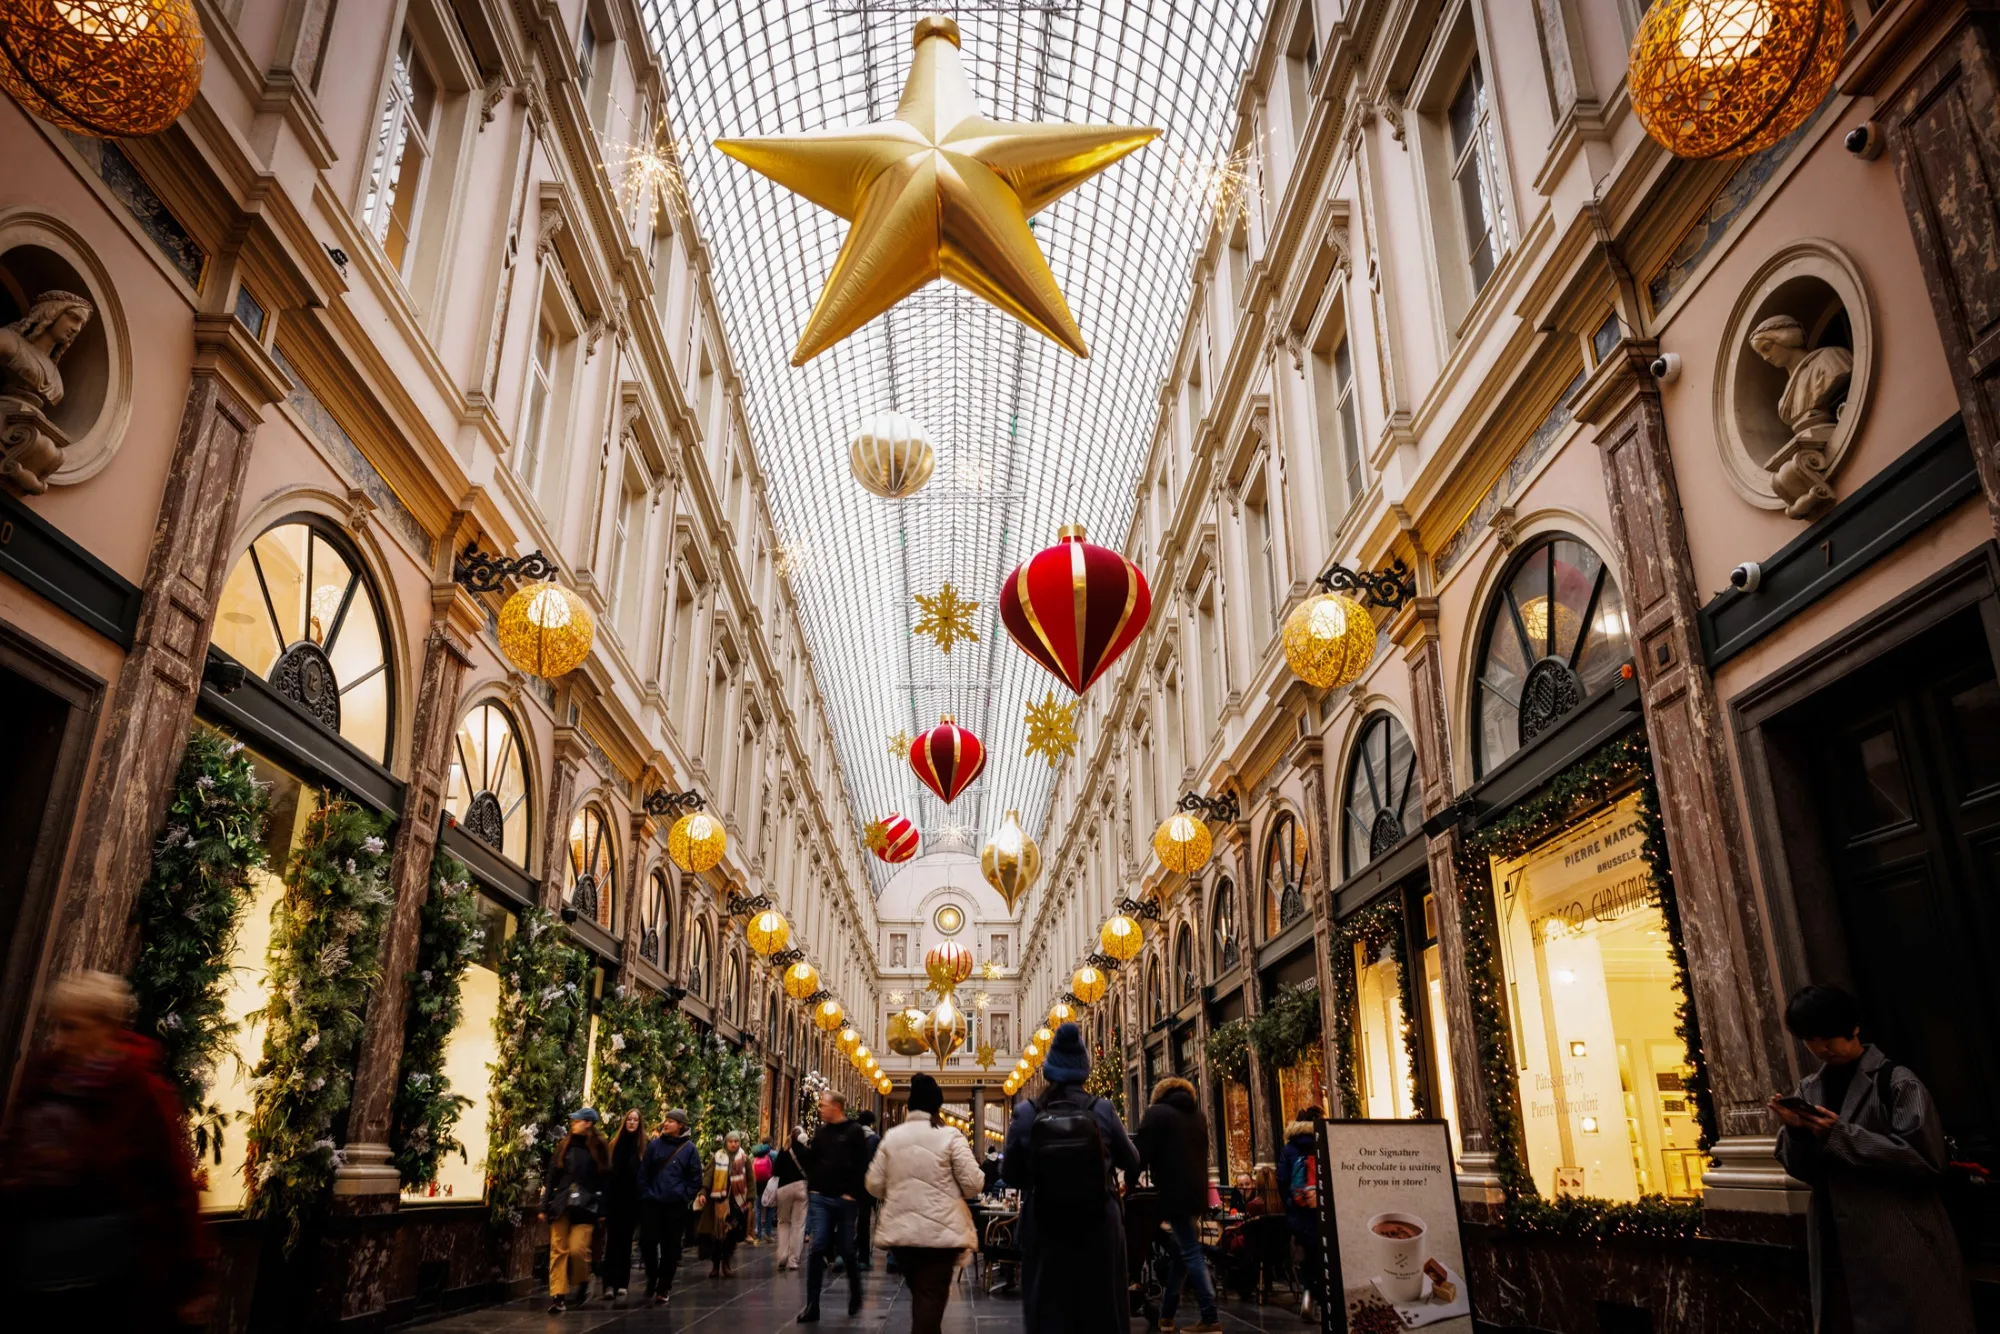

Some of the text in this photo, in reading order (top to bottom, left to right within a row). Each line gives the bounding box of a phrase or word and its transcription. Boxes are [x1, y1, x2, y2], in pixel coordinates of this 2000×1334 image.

[1564, 840, 1601, 868] PIERRE
[1597, 849, 1637, 873] BRUSSELS
[1574, 1064, 1585, 1089] by
[1531, 1092, 1598, 1118] Pierre Marcolini
[1359, 1147, 1420, 1159] Our Signature
[1341, 1162, 1442, 1173] hot chocolate is waiting
[1358, 1176, 1427, 1188] for you in store!
